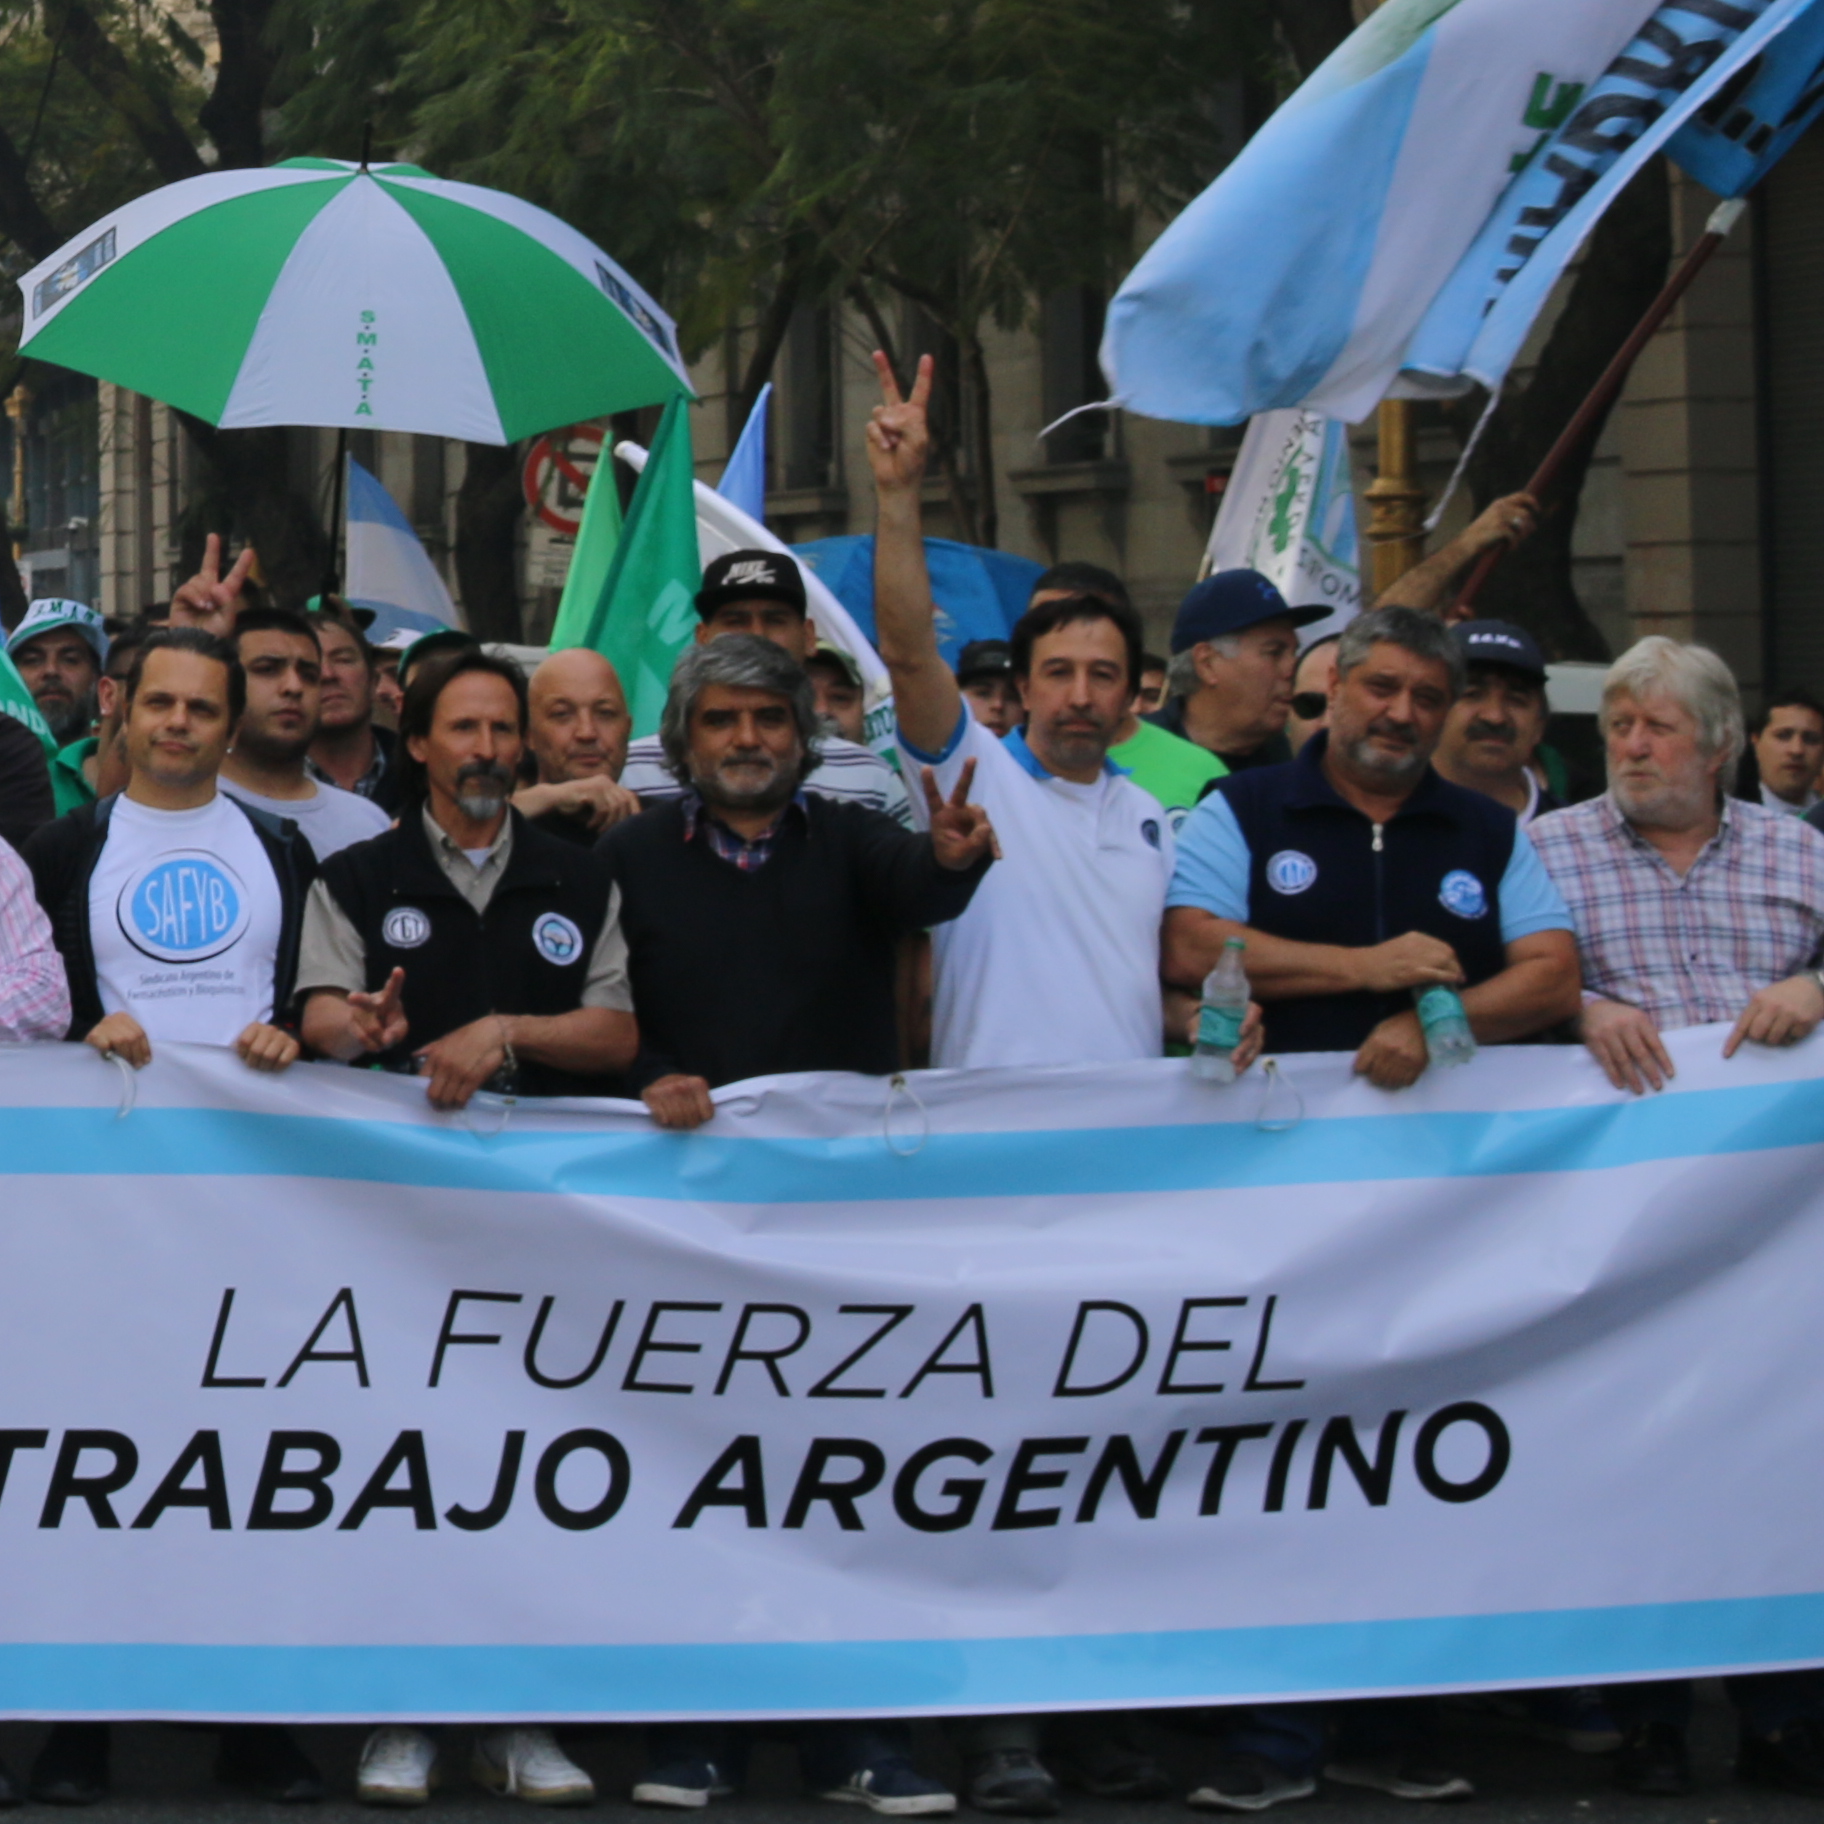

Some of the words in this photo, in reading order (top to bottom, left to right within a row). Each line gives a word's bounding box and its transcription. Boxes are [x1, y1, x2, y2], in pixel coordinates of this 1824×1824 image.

[146, 868, 227, 945] SAFYB
[201, 1288, 370, 1388] LA
[428, 1290, 994, 1399] FUERZA
[1052, 1294, 1307, 1398] DEL
[672, 1401, 1512, 1533] ARGENTINO
